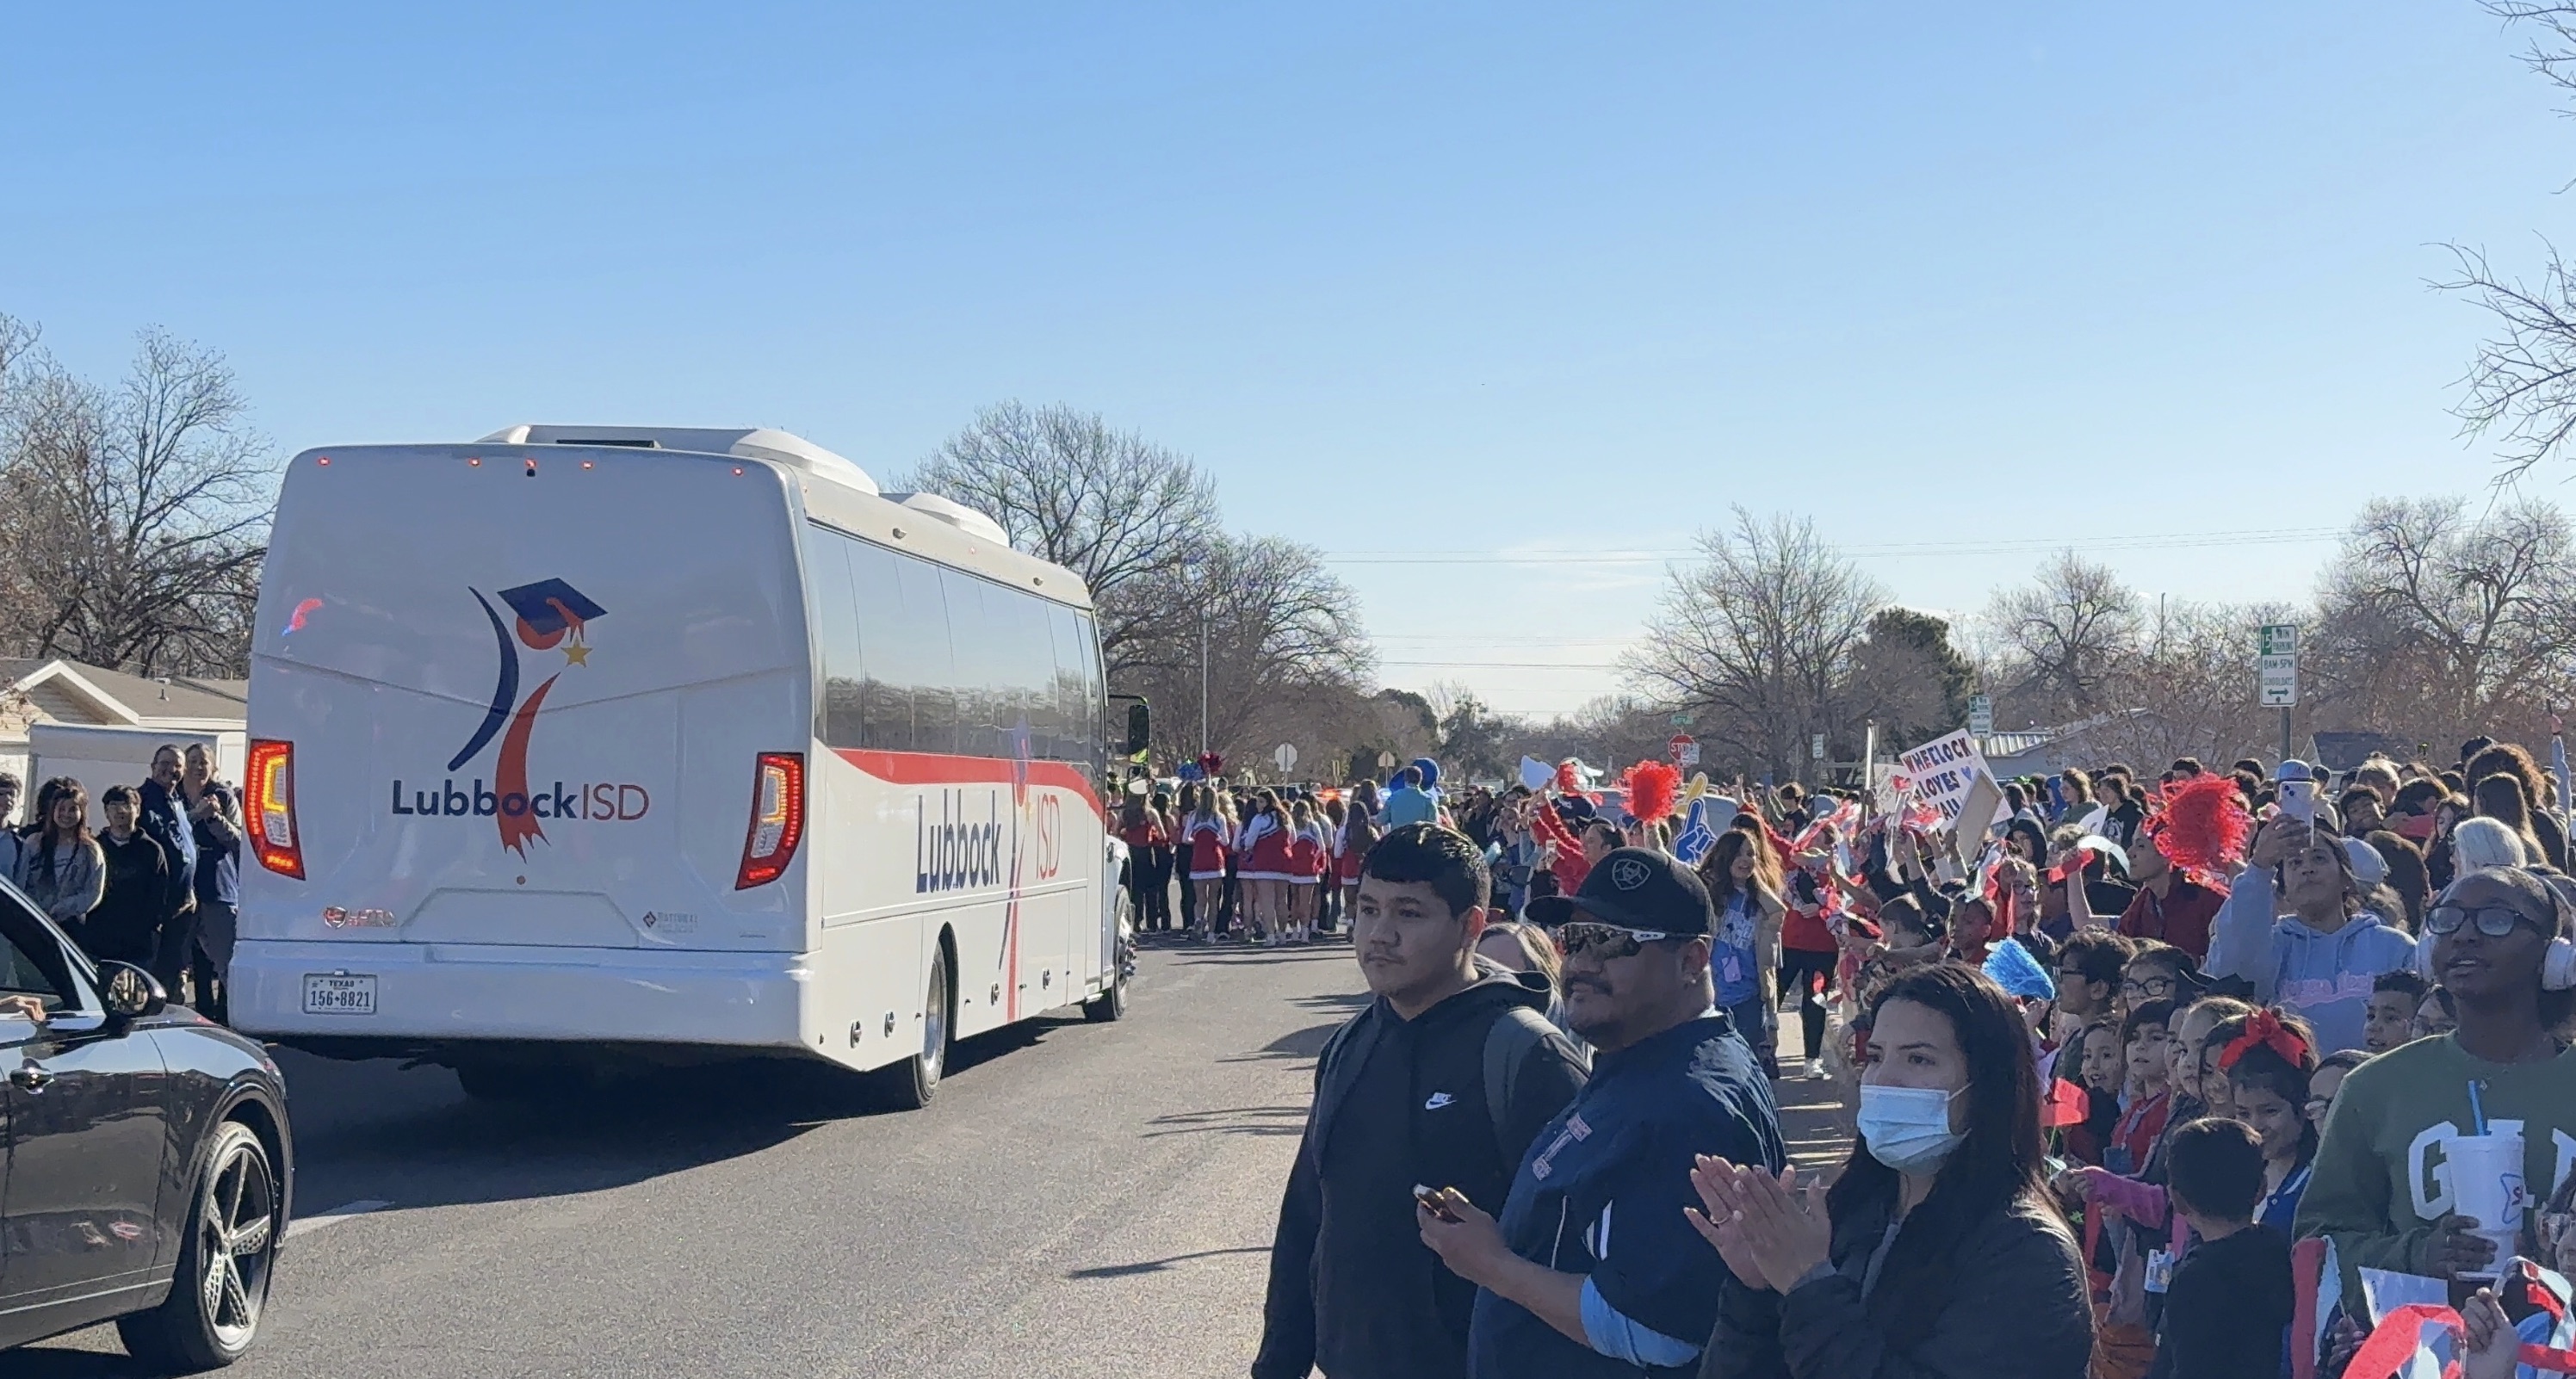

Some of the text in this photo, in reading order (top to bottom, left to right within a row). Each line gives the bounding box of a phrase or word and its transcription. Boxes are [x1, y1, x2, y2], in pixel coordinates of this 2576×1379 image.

[1903, 737, 1973, 774] WHEELOCK
[1918, 770, 1960, 800] LOVES
[916, 788, 1061, 894] Lubbock ISD
